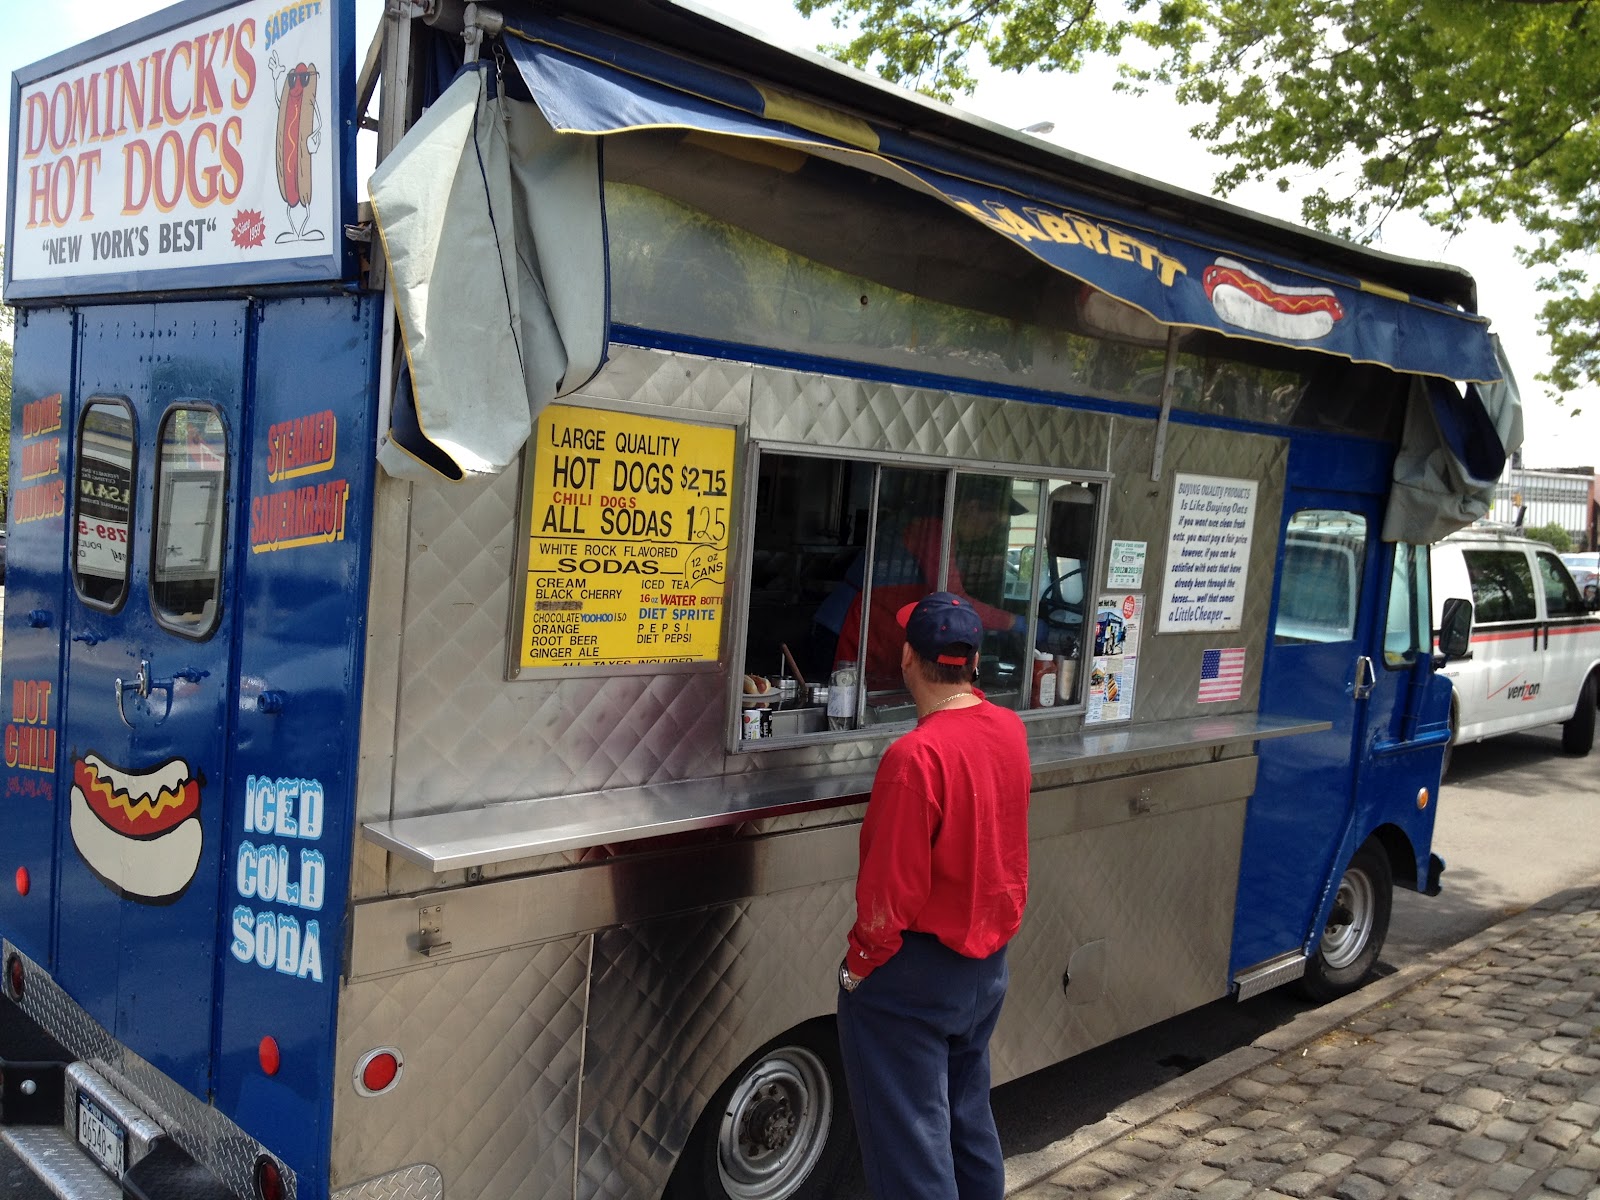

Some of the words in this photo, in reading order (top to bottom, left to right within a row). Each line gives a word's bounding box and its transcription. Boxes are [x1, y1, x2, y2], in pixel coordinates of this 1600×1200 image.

[264, 1, 322, 51] SABRETT
[23, 18, 256, 160] DOMINICK'S
[25, 148, 101, 229] HOT
[120, 116, 244, 215] DOGS
[91, 225, 149, 261] YORK'S
[22, 393, 62, 440] HOME
[267, 409, 337, 483] STEAMED
[552, 424, 605, 451] LARGE
[616, 432, 680, 457] QUALITY
[21, 437, 60, 481] MADE
[553, 455, 600, 490] HOT
[613, 460, 673, 495] DOGS
[553, 491, 592, 506] CHILI
[601, 496, 636, 509] DOGS
[1178, 483, 1201, 496] BUYING
[1201, 484, 1224, 499] QUALITY
[1224, 486, 1251, 500] PRODUCTS
[14, 479, 65, 525] ONIONS
[1181, 499, 1188, 510] Is
[1189, 500, 1206, 511] Like
[1206, 501, 1232, 516] Buying
[1232, 503, 1248, 514] Oats
[251, 479, 349, 554] SAUERKRAUT
[541, 505, 585, 534] ALL
[601, 508, 672, 537] SODAS
[687, 506, 725, 541] 1.25
[1183, 519, 1194, 529] you
[1195, 518, 1209, 527] want
[1220, 518, 1233, 528] clean
[1233, 519, 1246, 529] fresh
[1186, 534, 1197, 545] you
[1198, 534, 1211, 542] must
[1210, 535, 1221, 546] pay
[1221, 535, 1226, 543] a
[1225, 534, 1235, 544] fair
[1234, 535, 1248, 546] price
[540, 543, 578, 555] WHITE
[585, 545, 617, 557] ROCK
[624, 546, 678, 558] FLAVORED
[1209, 550, 1219, 561] you
[1220, 550, 1229, 558] can
[1229, 548, 1237, 558] be
[558, 558, 659, 575] SODAS
[691, 557, 701, 568] 12
[692, 562, 723, 580] CANS
[1171, 562, 1195, 573] satisfied
[1194, 562, 1206, 573] with
[1206, 564, 1219, 573] oats
[1219, 563, 1230, 573] that
[1229, 563, 1242, 573] have
[536, 578, 586, 588] CREAM
[641, 580, 664, 590] ICED
[672, 580, 689, 590] TEA
[1174, 578, 1194, 591] already
[1194, 578, 1206, 588] been
[1207, 578, 1227, 591] through
[1226, 578, 1236, 588] the
[536, 589, 573, 599] BLACK
[581, 589, 622, 600] CHERRY
[640, 594, 651, 603] 16
[660, 594, 696, 606] WATER
[1196, 593, 1209, 603] well
[1208, 593, 1219, 603] that
[1219, 595, 1235, 603] comes
[533, 613, 580, 623] CHOCOLATE
[580, 613, 614, 623] YOOHOO
[639, 608, 667, 620] DIET
[672, 609, 715, 620] SPRITE
[1168, 611, 1174, 621] a
[1174, 606, 1195, 622] Little
[1194, 605, 1223, 624] Cheaper
[532, 624, 580, 634] ORANGE
[532, 636, 563, 646] ROOT
[570, 636, 598, 646] BEER
[637, 634, 659, 644] DIET
[664, 633, 692, 643] PEPSI
[530, 648, 572, 658] GINGER
[579, 647, 599, 657] ALE
[1507, 681, 1540, 701] verizon
[12, 679, 51, 724] HOT
[4, 724, 56, 773] CHILI
[244, 775, 324, 840] ICED
[237, 840, 325, 911] COLD
[231, 905, 323, 983] SODA
